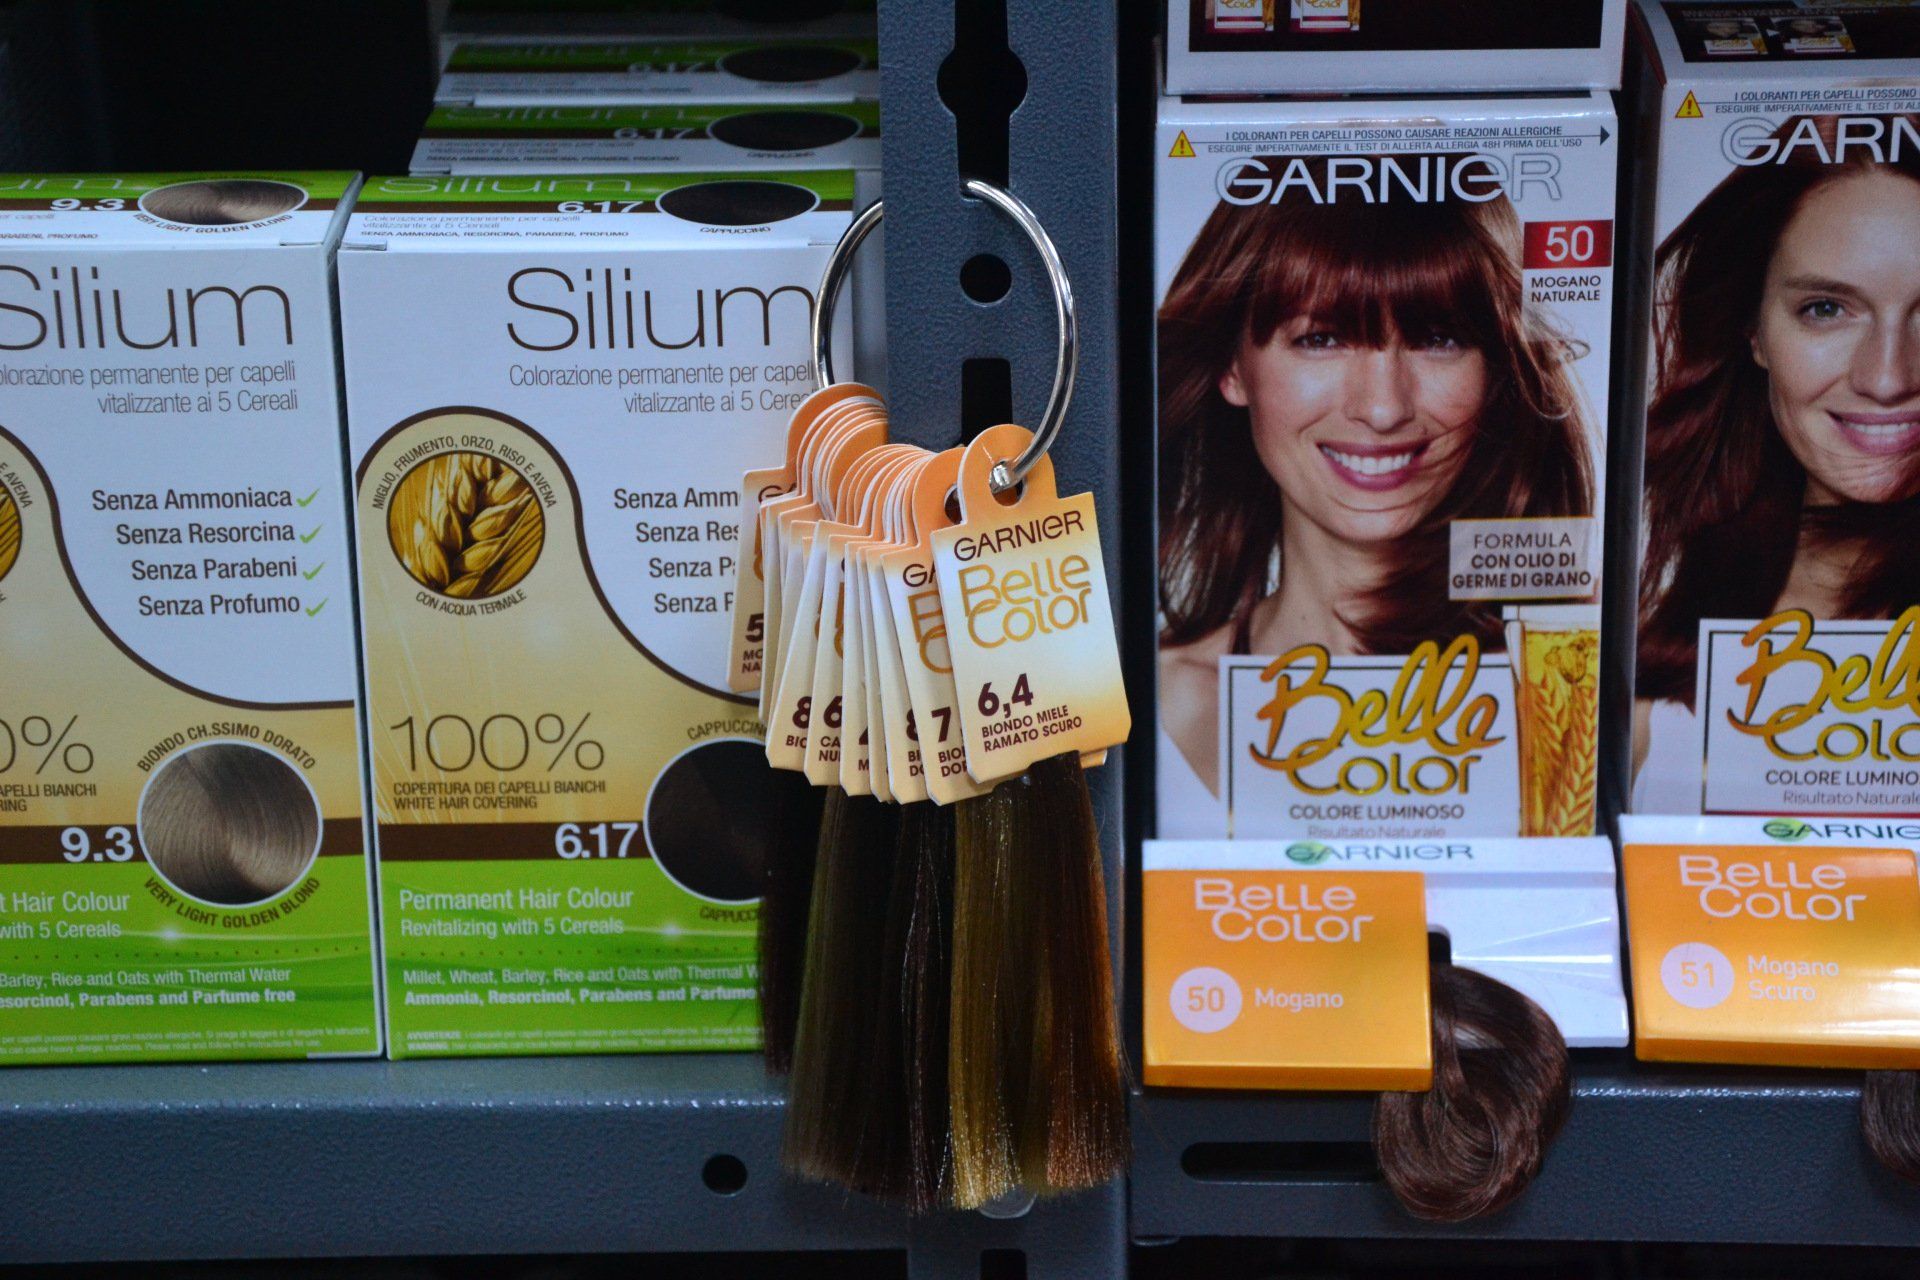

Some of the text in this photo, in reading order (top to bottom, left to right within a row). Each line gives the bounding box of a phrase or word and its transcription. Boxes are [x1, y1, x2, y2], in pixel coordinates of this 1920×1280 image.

[1741, 88, 1917, 101] COLORANTI PER CAPELLI POSSONO
[1715, 104, 1761, 113] ESEGUIRE
[1867, 102, 1890, 111] TEST
[1232, 126, 1562, 141] COLORANTI PER CAPELLI POSSONO CAUSARE REAZIONI ALLERGICHE
[1208, 139, 1533, 153] ESEGUIRE IMPERATIVAMENTE TEST ALLERTA ALLERGIA 48H PRIMA
[379, 178, 631, 194] Silium
[1216, 152, 1562, 206] GARNIER
[51, 198, 125, 212] 9.3
[557, 201, 643, 214] 6.17
[156, 214, 293, 235] LIGHT GOLDEN BLOND
[1545, 225, 1595, 262] 50
[1531, 275, 1601, 289] MOGANO
[1531, 289, 1601, 303] NATURALE
[507, 267, 816, 352] Silium
[90, 360, 296, 388] permanente per capelli
[509, 361, 758, 388] Colorazione permanente per
[98, 389, 298, 413] vitalizzante ai 5 Cereali
[624, 390, 754, 413] vitalizzante ai 5
[500, 444, 526, 467] RISO
[531, 468, 557, 509] AVENA
[4, 470, 33, 508] AVENA
[92, 488, 292, 511] Senza Ammoniaca
[614, 488, 677, 510] Senza
[116, 522, 295, 545] Senza Resorcina
[636, 522, 699, 543] Senza
[954, 510, 1085, 562] GARNIER
[1474, 532, 1572, 549] FORMULA
[131, 557, 297, 581] Senza Parabeni
[649, 557, 712, 579] Senza
[1471, 552, 1576, 569] CON OLIO DI
[958, 555, 1092, 617] Belle
[1452, 571, 1592, 589] GERME DI GRANO
[139, 593, 300, 616] Senza Profumo
[415, 588, 528, 616] CON ACQUA TERMALE
[654, 592, 718, 614] Senza
[967, 586, 1091, 649] Color
[978, 672, 1034, 719] 6,4
[1250, 633, 1506, 769] Belle
[981, 704, 1069, 738] BIONDO MIELE
[390, 711, 606, 773] 100%
[983, 715, 1083, 753] RAMATO SCURO
[137, 731, 185, 773] BIONDO
[186, 721, 260, 742] CH.SSIMO
[264, 729, 316, 771] DORATO
[1286, 740, 1482, 796] Color
[1766, 769, 1840, 786] COLORE
[43, 783, 97, 797] BIANCHI
[394, 780, 606, 795] COPERTURA DEI CAPELLI BIANCHI
[1782, 791, 1854, 805] Risultato
[394, 795, 537, 810] WHITE HAIR COVERING
[1289, 803, 1464, 820] COLORE LUMINOSO
[555, 822, 639, 859] 6.17
[1307, 825, 1446, 839] Risultato Naturale
[60, 826, 134, 863] 9.3
[1285, 844, 1475, 862] GARNIER
[1679, 855, 1846, 890] Belle
[12, 890, 131, 912] Hair Colour
[143, 877, 321, 929] VERY LIGHT GOLDEN BLOND
[400, 886, 634, 912] Permanent Hair Colour
[1194, 877, 1357, 912] Belle
[1699, 884, 1867, 921] Color
[38, 920, 121, 939] 5 Cereals
[400, 916, 624, 939] Revitalizing with 5 Cereals
[1211, 906, 1374, 943] Color
[51, 968, 291, 986] Rice and Oats with Thermal Water
[554, 968, 584, 983] Rice
[588, 967, 614, 982] and
[618, 967, 649, 982] Oats
[653, 966, 683, 980] with
[687, 965, 744, 981] Thermal
[1681, 955, 1840, 989] 51 Mogano
[79, 988, 296, 1007] Parabens and Parfume free
[580, 988, 651, 1004] Parabens
[657, 986, 685, 1001] and
[1186, 986, 1344, 1014] 50 Mogano
[1749, 980, 1817, 1002] Scuro
